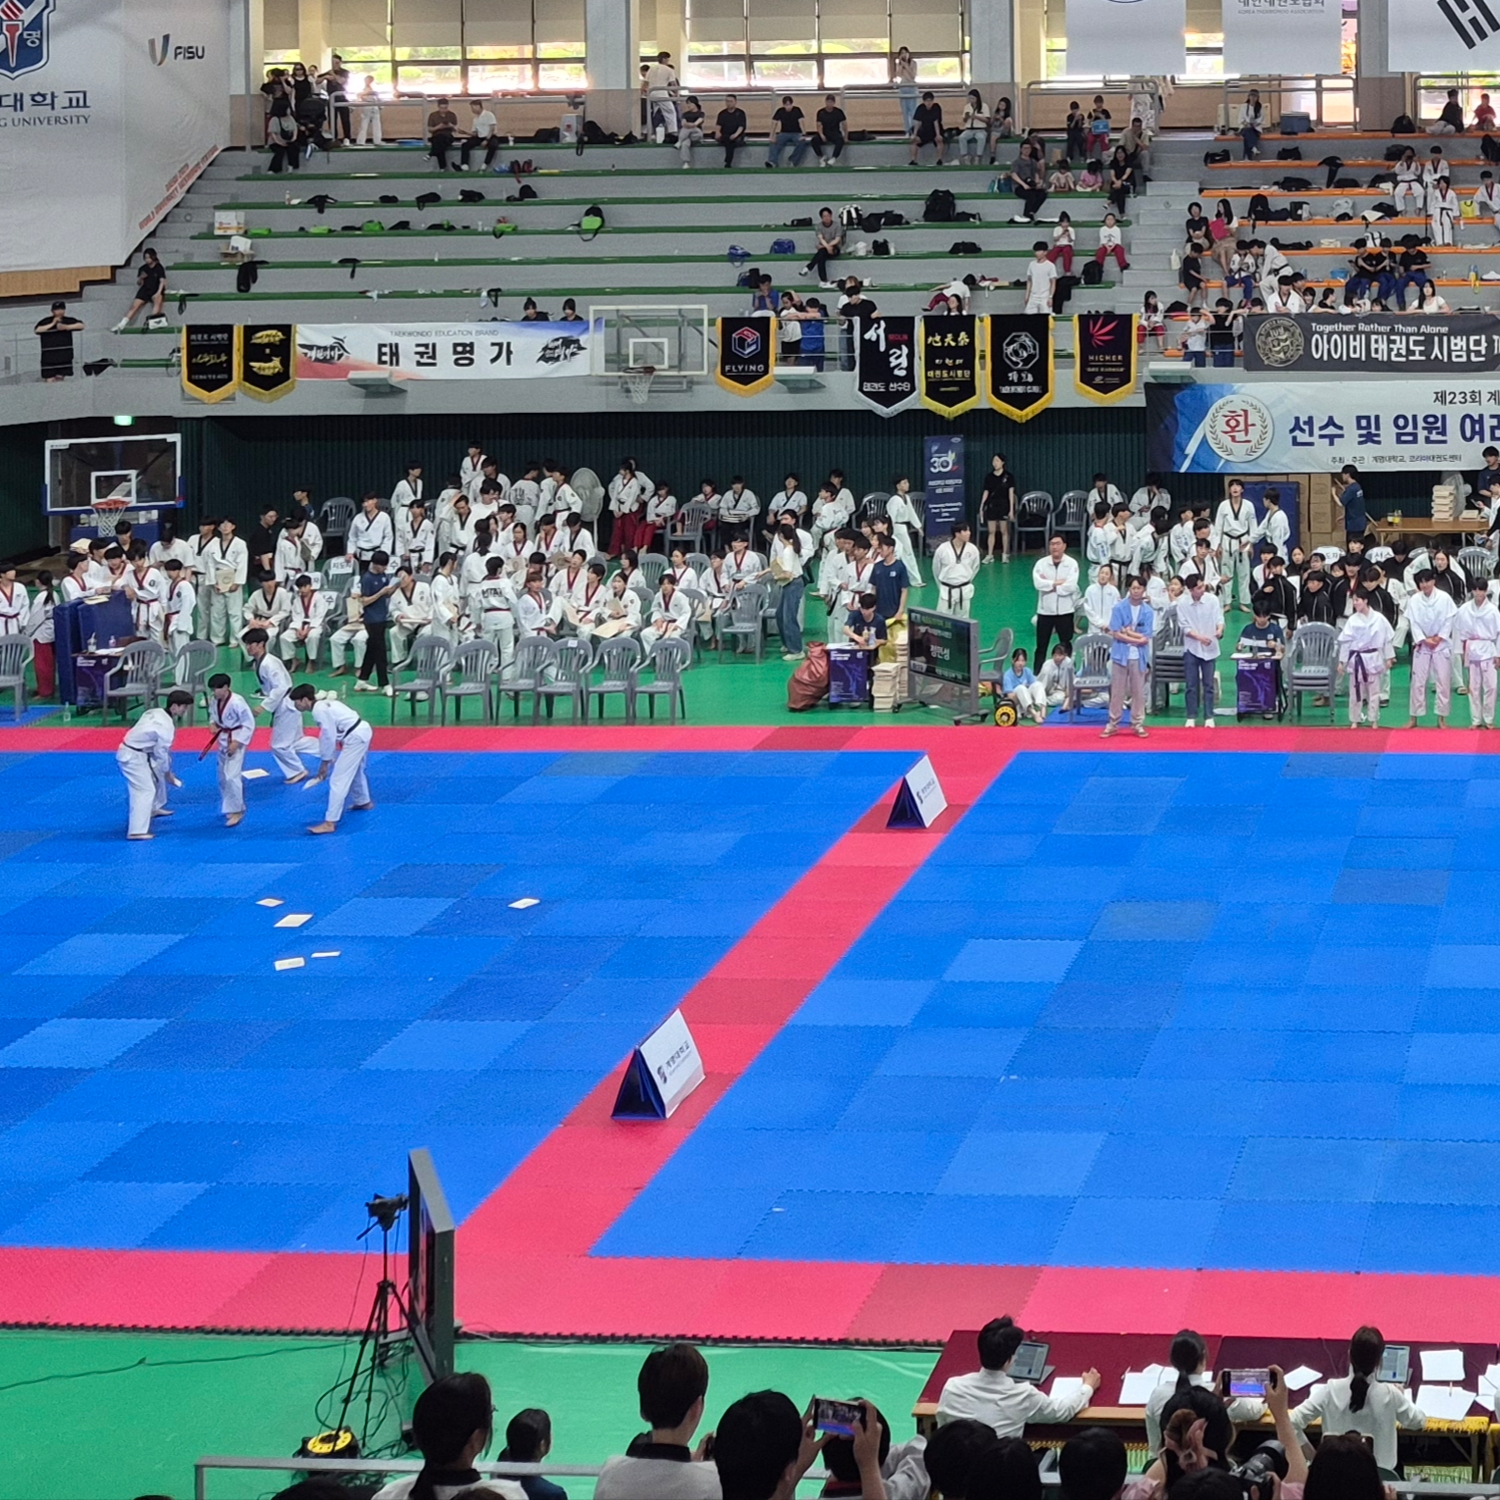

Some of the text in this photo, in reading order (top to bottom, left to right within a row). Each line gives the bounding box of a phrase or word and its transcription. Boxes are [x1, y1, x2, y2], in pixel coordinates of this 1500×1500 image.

[23, 30, 41, 48] 명
[173, 45, 206, 61] FISU
[12, 114, 91, 128] UNIVERSITY
[1310, 322, 1449, 334] Together Rather Than Alone
[377, 341, 514, 368] 태권명가
[1310, 334, 1488, 363] 아이비 태권도 시범단
[724, 364, 765, 373] FLYING
[1432, 390, 1482, 407] 제23회
[1220, 408, 1257, 444] 환
[1288, 415, 1345, 447] 선수
[1355, 414, 1382, 446] 및
[1392, 413, 1448, 446] 임원
